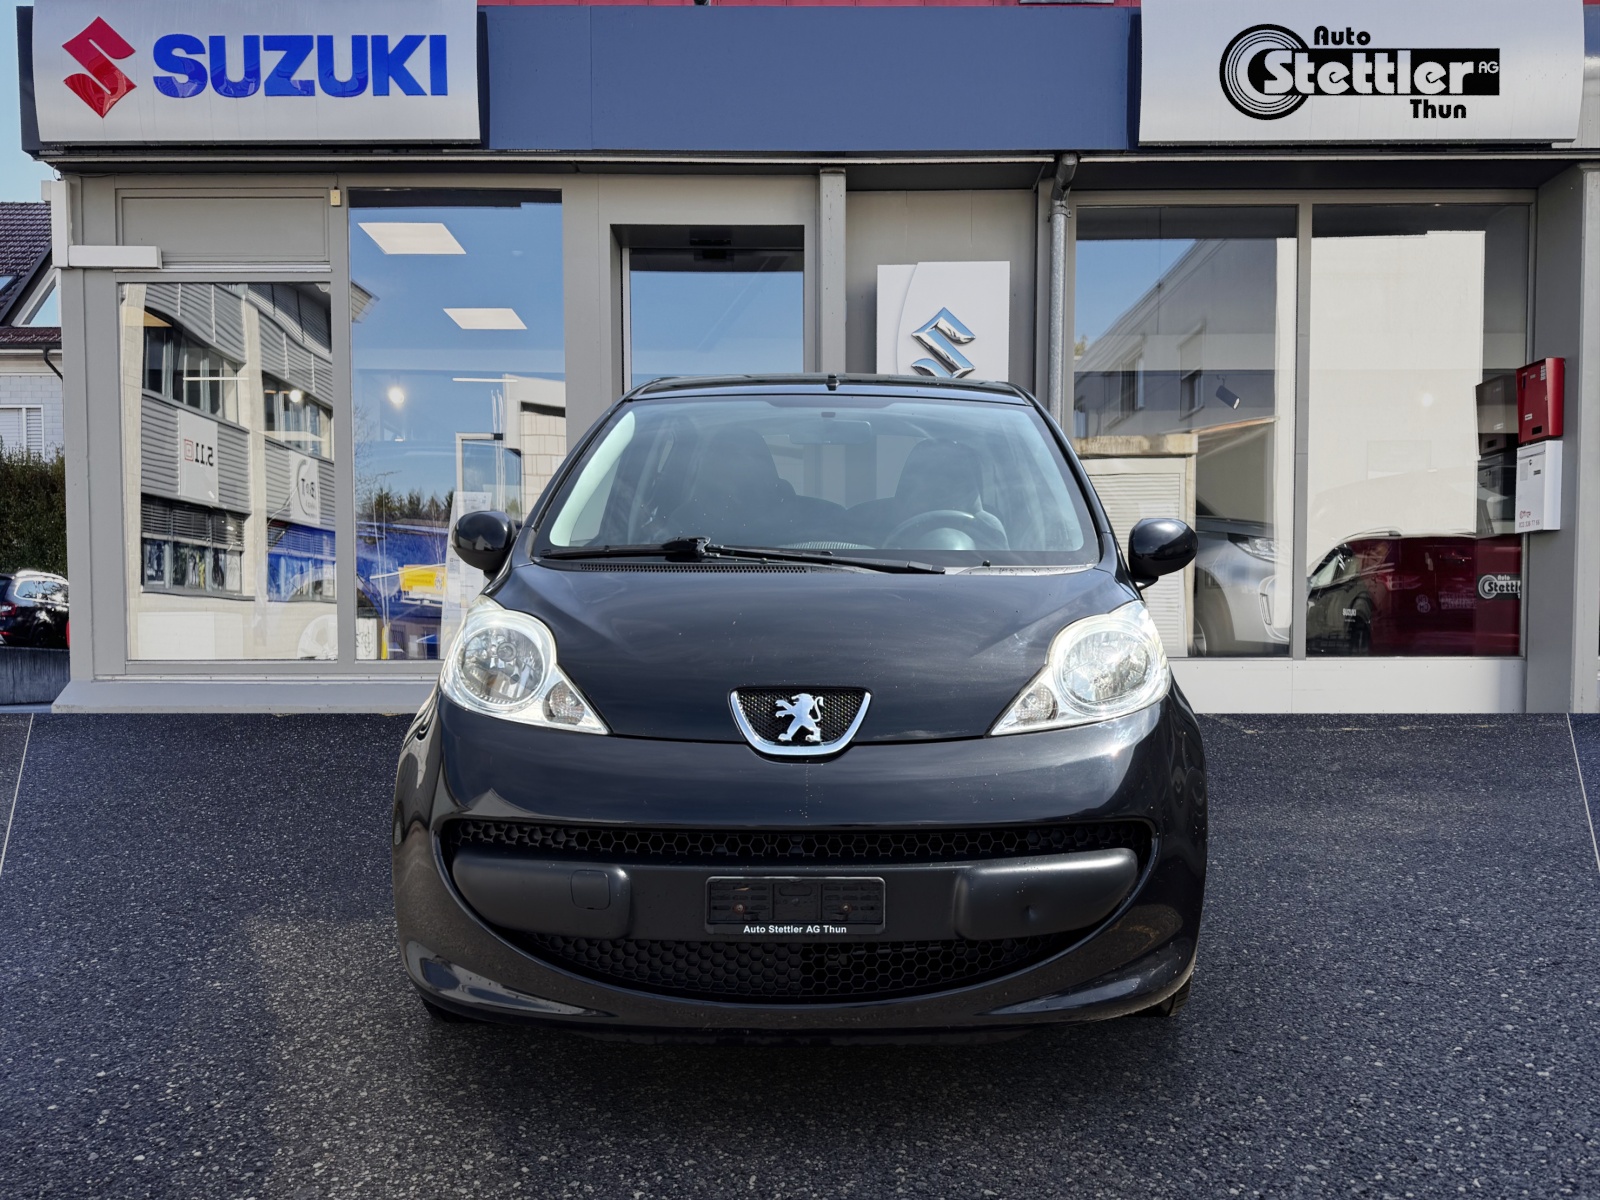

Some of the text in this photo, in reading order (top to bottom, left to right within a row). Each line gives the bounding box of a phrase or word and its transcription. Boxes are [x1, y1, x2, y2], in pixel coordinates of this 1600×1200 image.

[1314, 25, 1371, 46] Auto
[153, 34, 448, 98] SUZUKI
[1264, 50, 1499, 95] Stettler AG
[1410, 98, 1467, 119] Thun
[743, 924, 847, 934] Auto Stettler AG Thun
